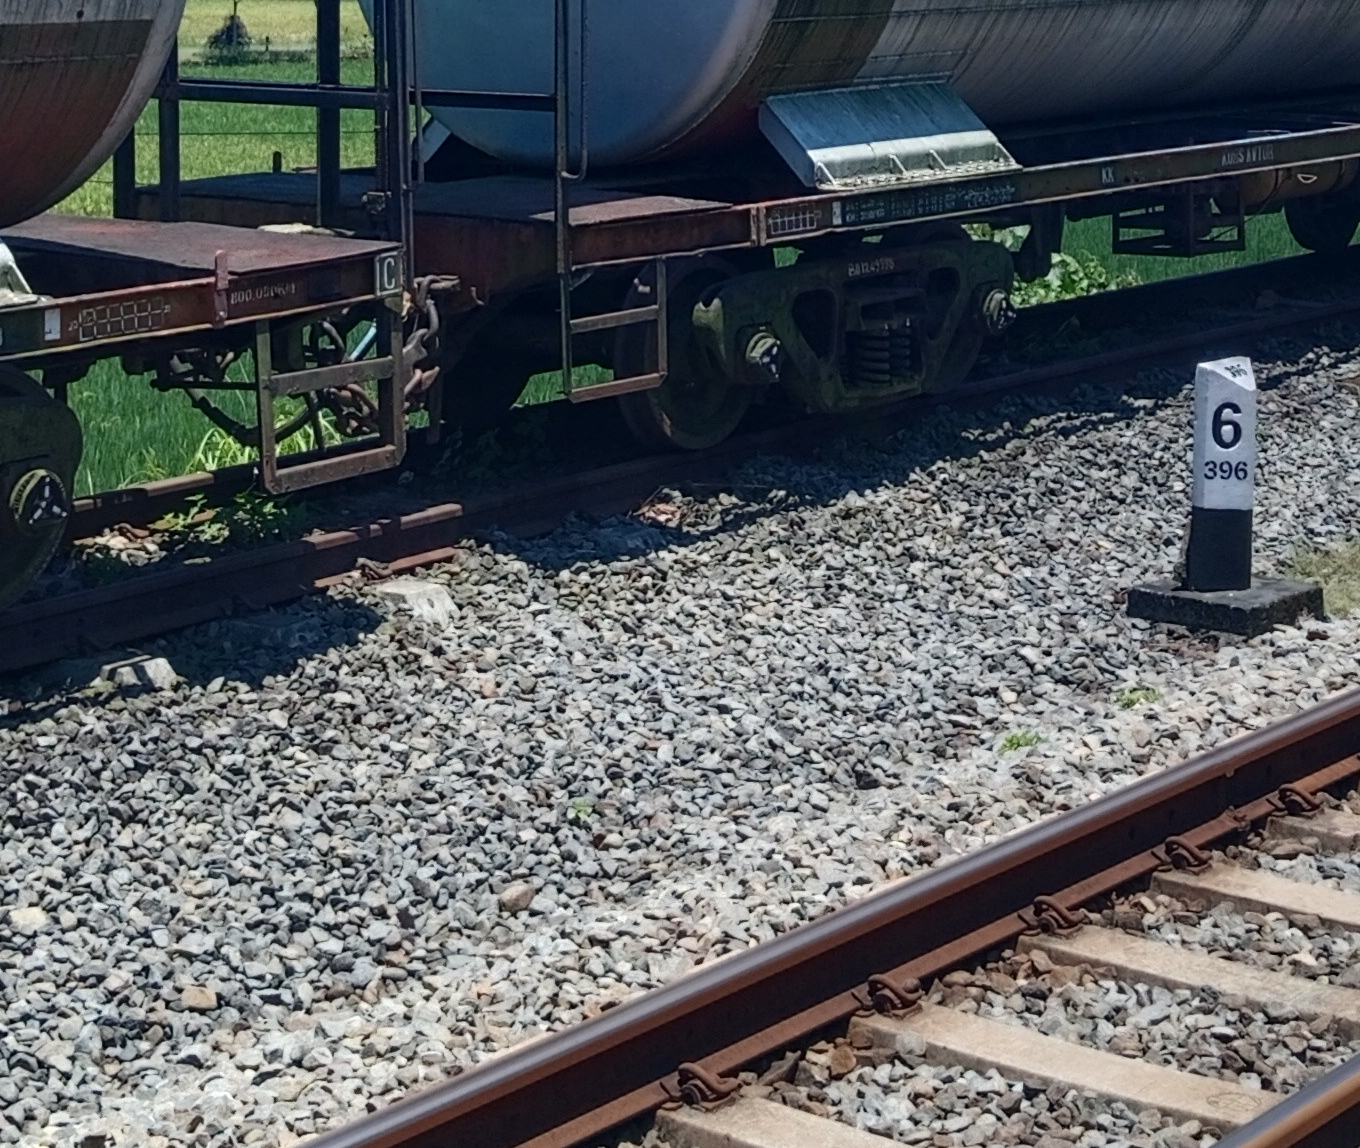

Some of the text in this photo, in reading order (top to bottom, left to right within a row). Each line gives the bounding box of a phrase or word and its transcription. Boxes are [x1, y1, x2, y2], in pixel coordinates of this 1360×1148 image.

[383, 257, 396, 291] C
[1211, 402, 1242, 449] 6
[1203, 460, 1249, 481] 396
